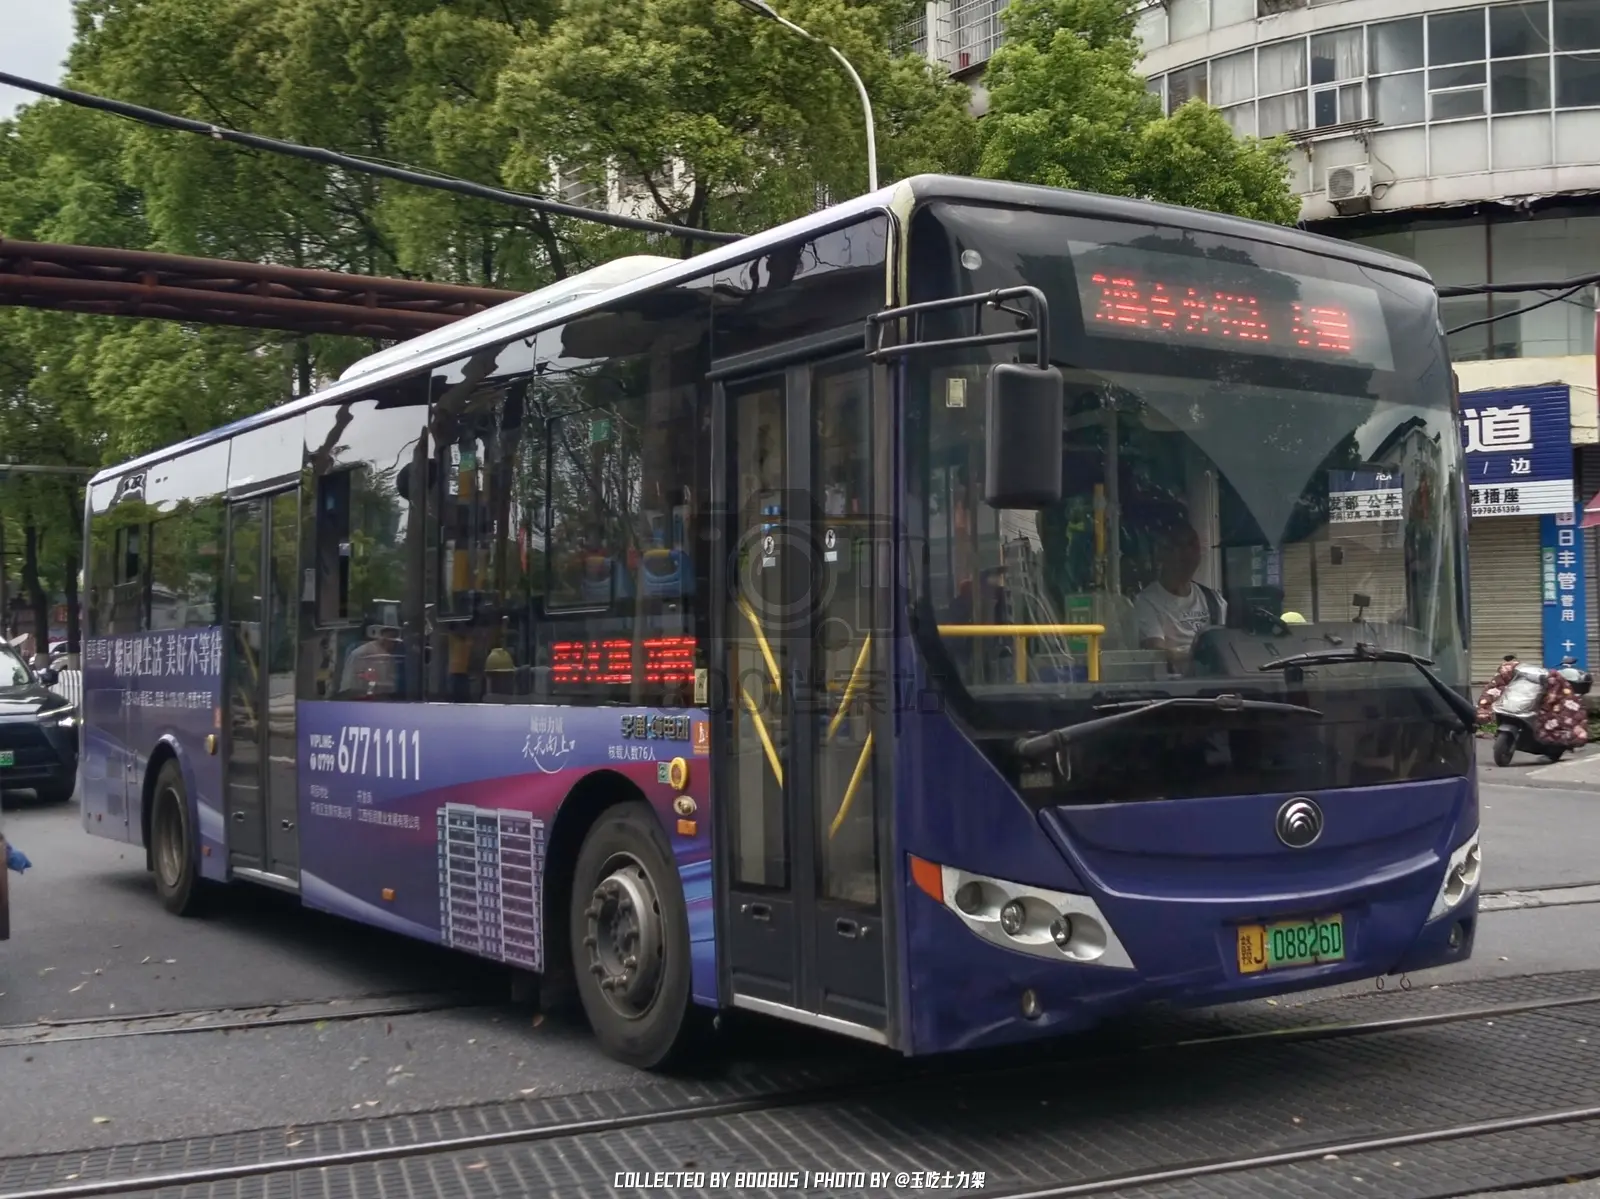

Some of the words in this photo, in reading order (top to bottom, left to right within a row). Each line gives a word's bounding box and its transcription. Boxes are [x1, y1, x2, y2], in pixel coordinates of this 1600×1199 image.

[1464, 405, 1534, 453] 道
[1511, 458, 1531, 474] 边
[165, 632, 222, 676] 美好不等待
[338, 726, 420, 780] 6771111
[1273, 921, 1342, 961] 08826D
